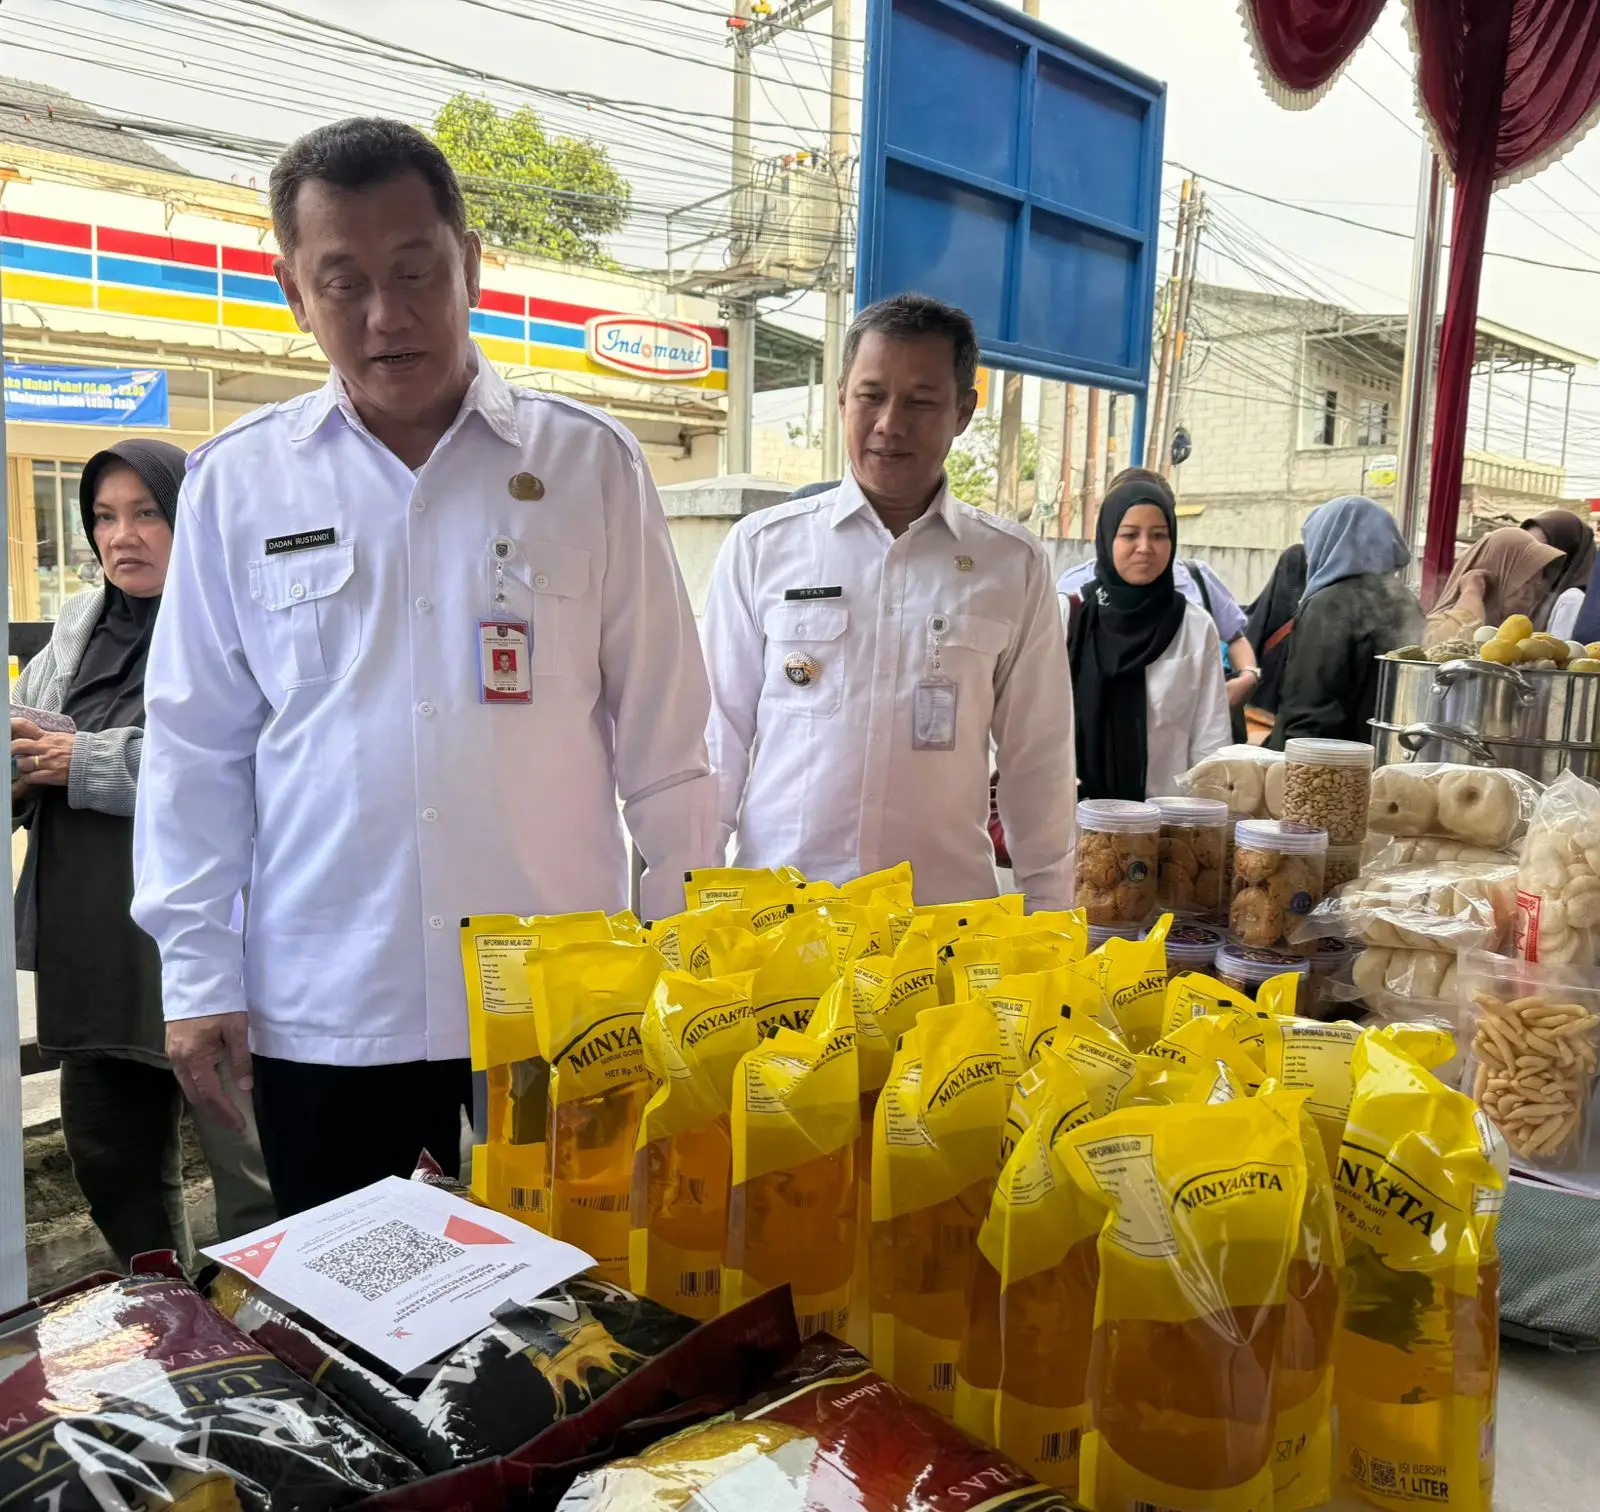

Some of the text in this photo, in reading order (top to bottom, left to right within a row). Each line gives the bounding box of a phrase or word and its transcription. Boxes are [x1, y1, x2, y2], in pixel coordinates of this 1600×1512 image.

[602, 329, 702, 364] Indomaret
[268, 532, 330, 550] DADAN RUSTANDI
[752, 910, 788, 932] MINYAK
[685, 1004, 756, 1048] MINYAKITA
[567, 1026, 642, 1074] MINYA
[604, 1065, 646, 1078] HET Rp 15.
[938, 1061, 1001, 1107] MINYAKIT
[1180, 1170, 1284, 1213] MINYAKITA
[158, 1340, 252, 1366] BERA
[831, 1383, 882, 1409] Alami
[947, 1463, 1020, 1501] RAS
[1399, 1463, 1447, 1477] ISI BERSIH
[1399, 1477, 1449, 1498] 1 LITER
